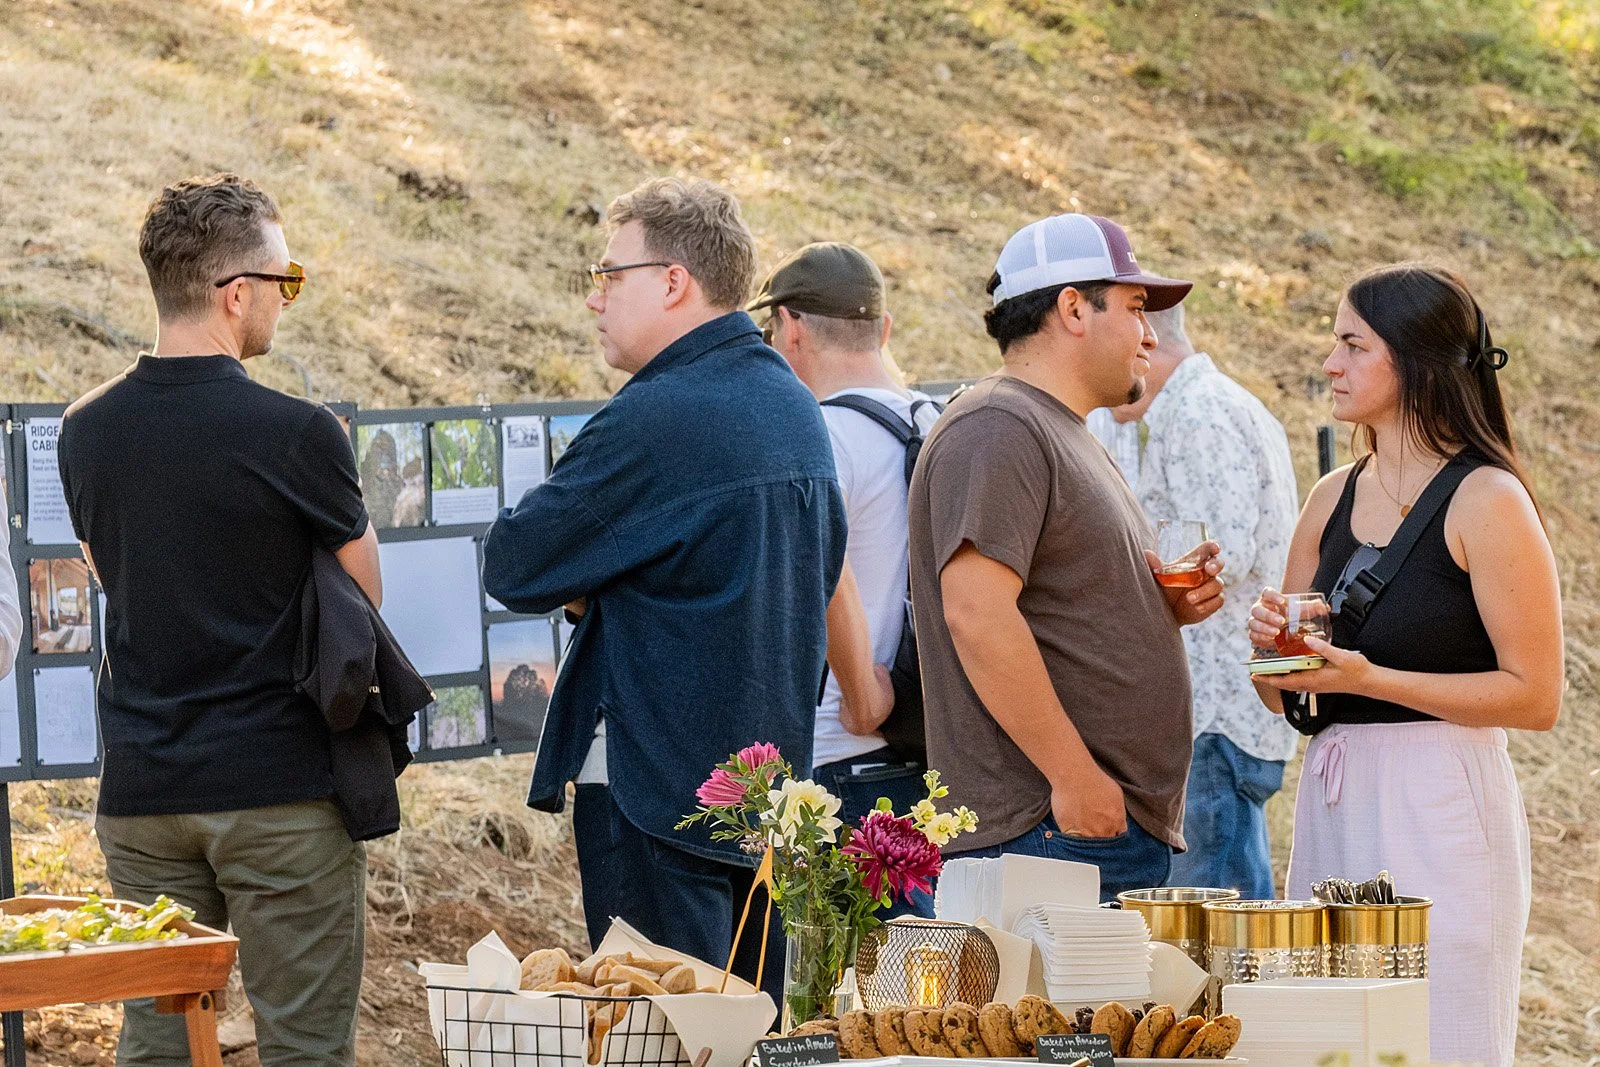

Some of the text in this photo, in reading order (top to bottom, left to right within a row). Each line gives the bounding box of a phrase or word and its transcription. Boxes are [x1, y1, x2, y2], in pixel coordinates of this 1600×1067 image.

[31, 425, 59, 437] RIDGE
[761, 1042, 793, 1054] Baked
[792, 1042, 806, 1052] in
[1038, 1037, 1063, 1047] Baked
[1063, 1037, 1075, 1046] in
